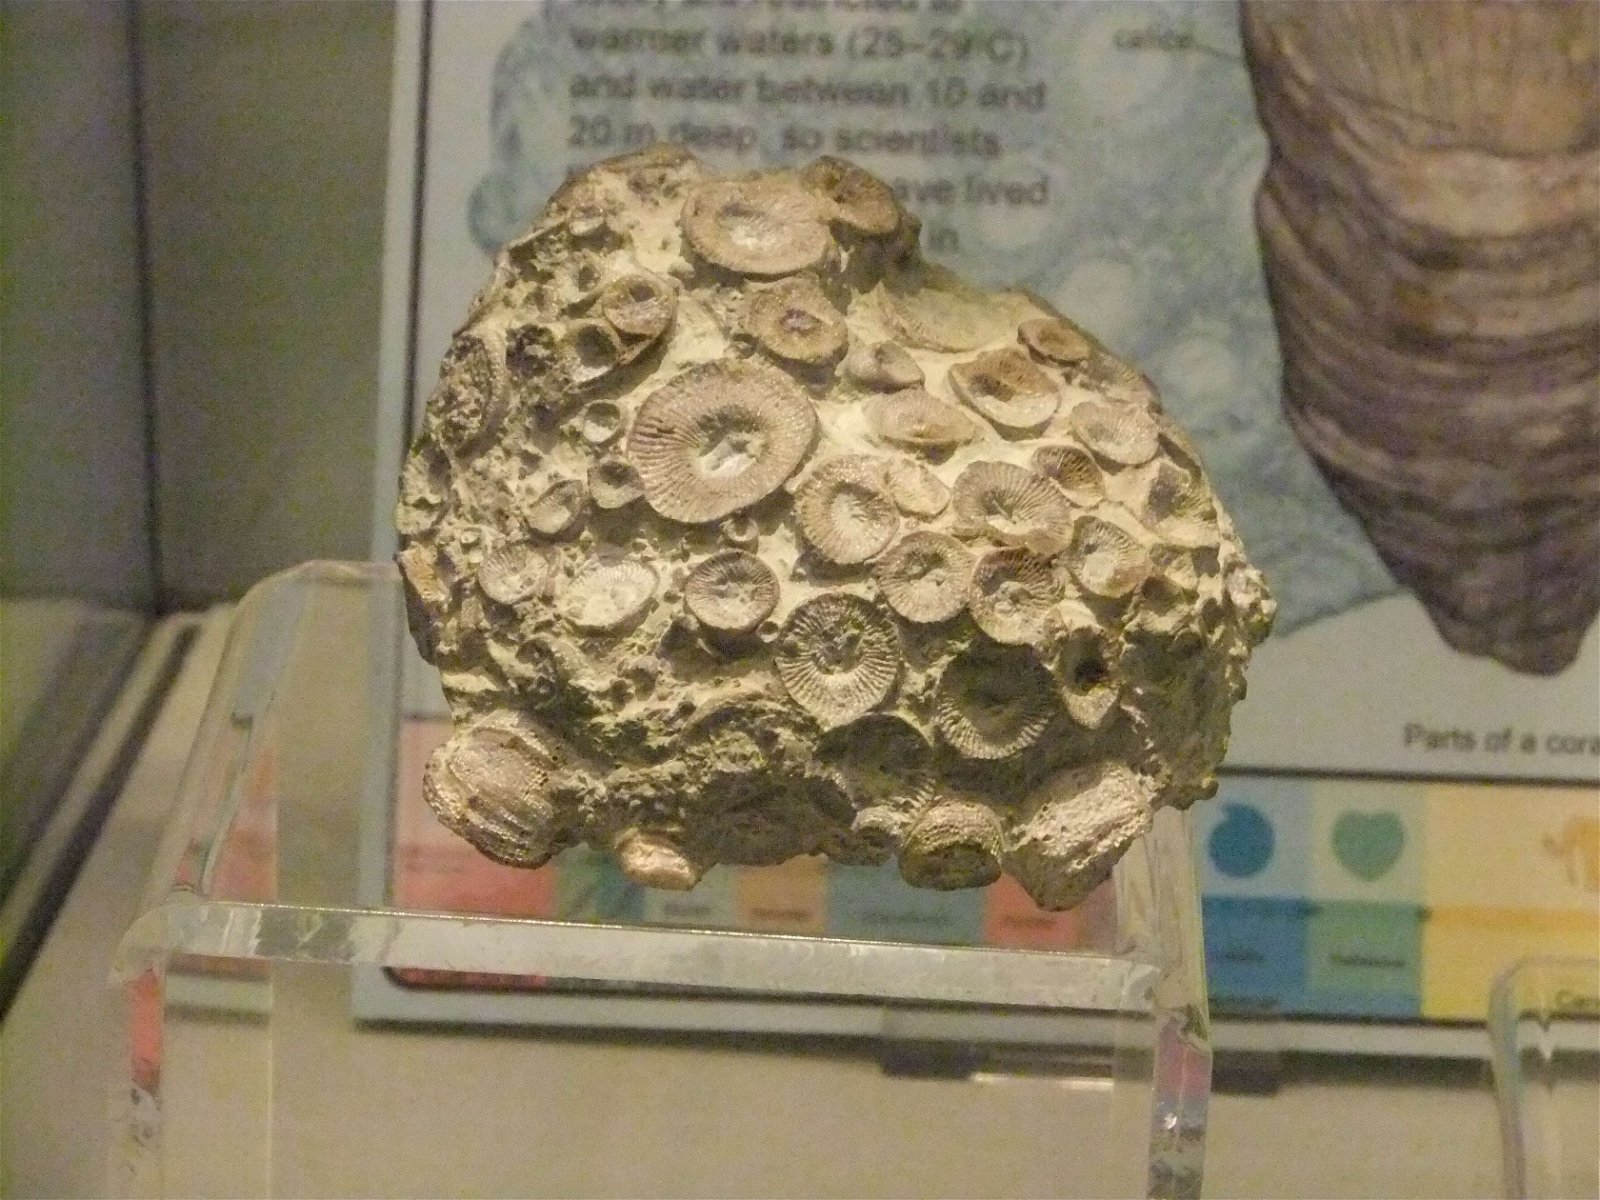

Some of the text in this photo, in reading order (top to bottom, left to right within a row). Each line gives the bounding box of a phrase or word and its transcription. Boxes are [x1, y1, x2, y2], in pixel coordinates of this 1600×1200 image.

[716, 31, 834, 56] waters
[569, 70, 1047, 112] and water between 10 and
[568, 114, 612, 146] 20
[781, 125, 824, 152] so
[834, 125, 1001, 160] scientists
[895, 175, 1049, 209] ave lived
[1403, 722, 1477, 753] Parts
[1484, 724, 1513, 753] of
[1520, 734, 1538, 754] a
